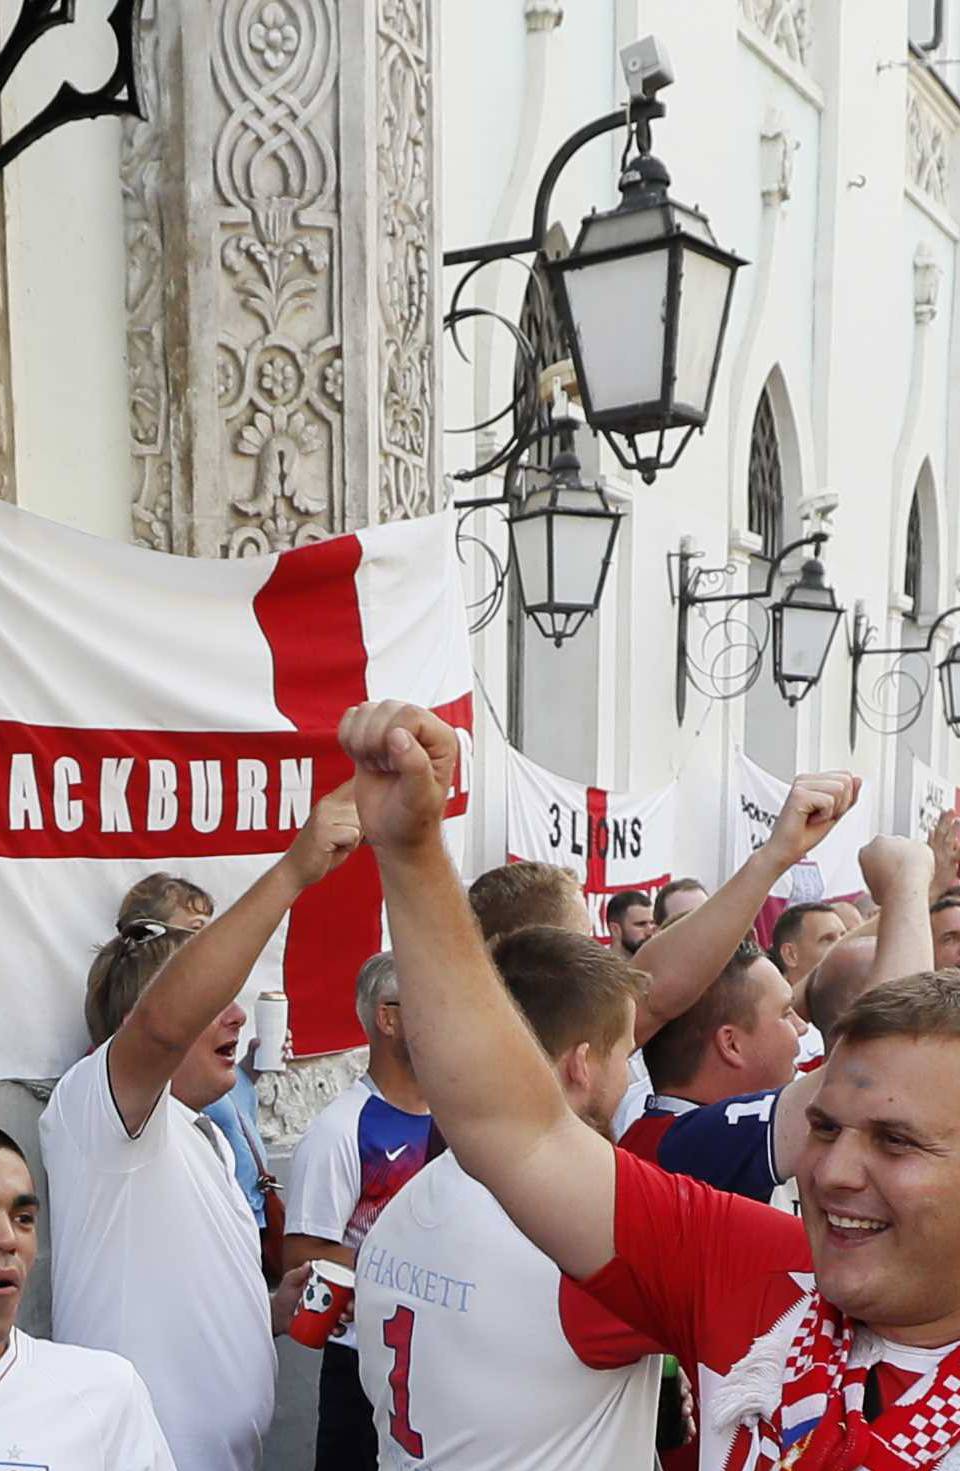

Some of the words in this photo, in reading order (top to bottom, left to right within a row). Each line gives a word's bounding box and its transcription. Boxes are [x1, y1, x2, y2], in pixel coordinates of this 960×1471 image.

[548, 803, 562, 848] 3
[571, 810, 643, 860] LIONS
[364, 1247, 477, 1313] HACKETT
[383, 1304, 424, 1459] 1
